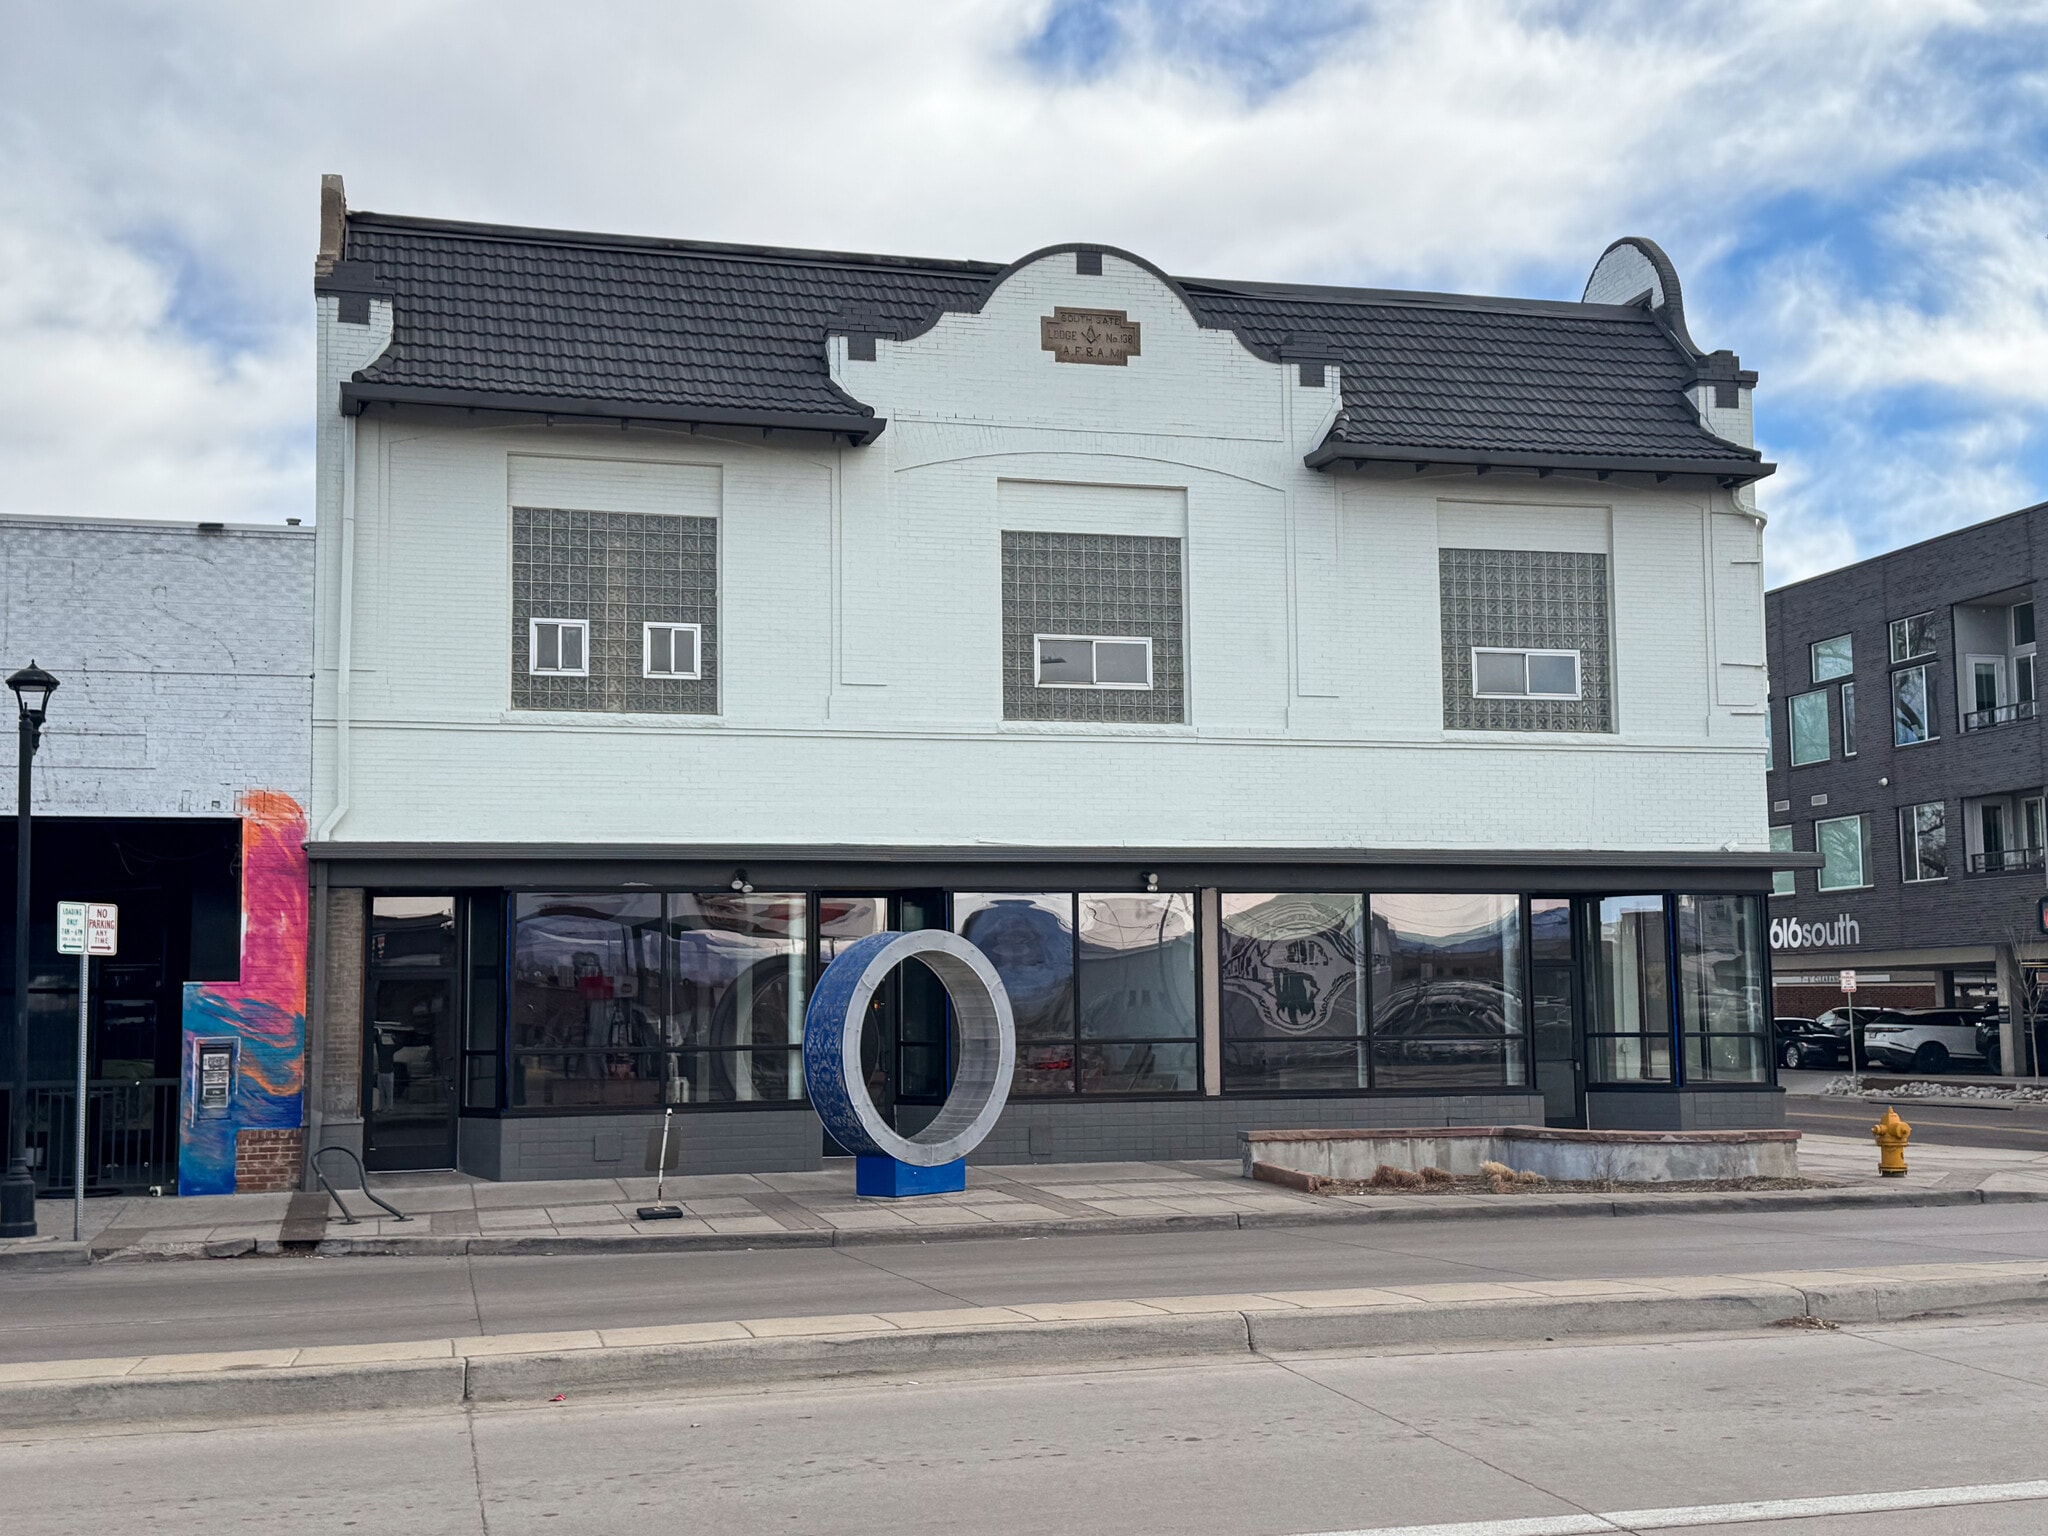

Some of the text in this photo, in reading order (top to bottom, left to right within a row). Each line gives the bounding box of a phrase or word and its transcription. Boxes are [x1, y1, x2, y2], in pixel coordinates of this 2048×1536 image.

[1061, 314, 1092, 324] SOUTH
[1048, 329, 1077, 341] LODGE
[62, 908, 82, 916] LOADING
[96, 908, 108, 918] NO
[66, 918, 78, 926] ONLY
[88, 919, 115, 930] PARKING
